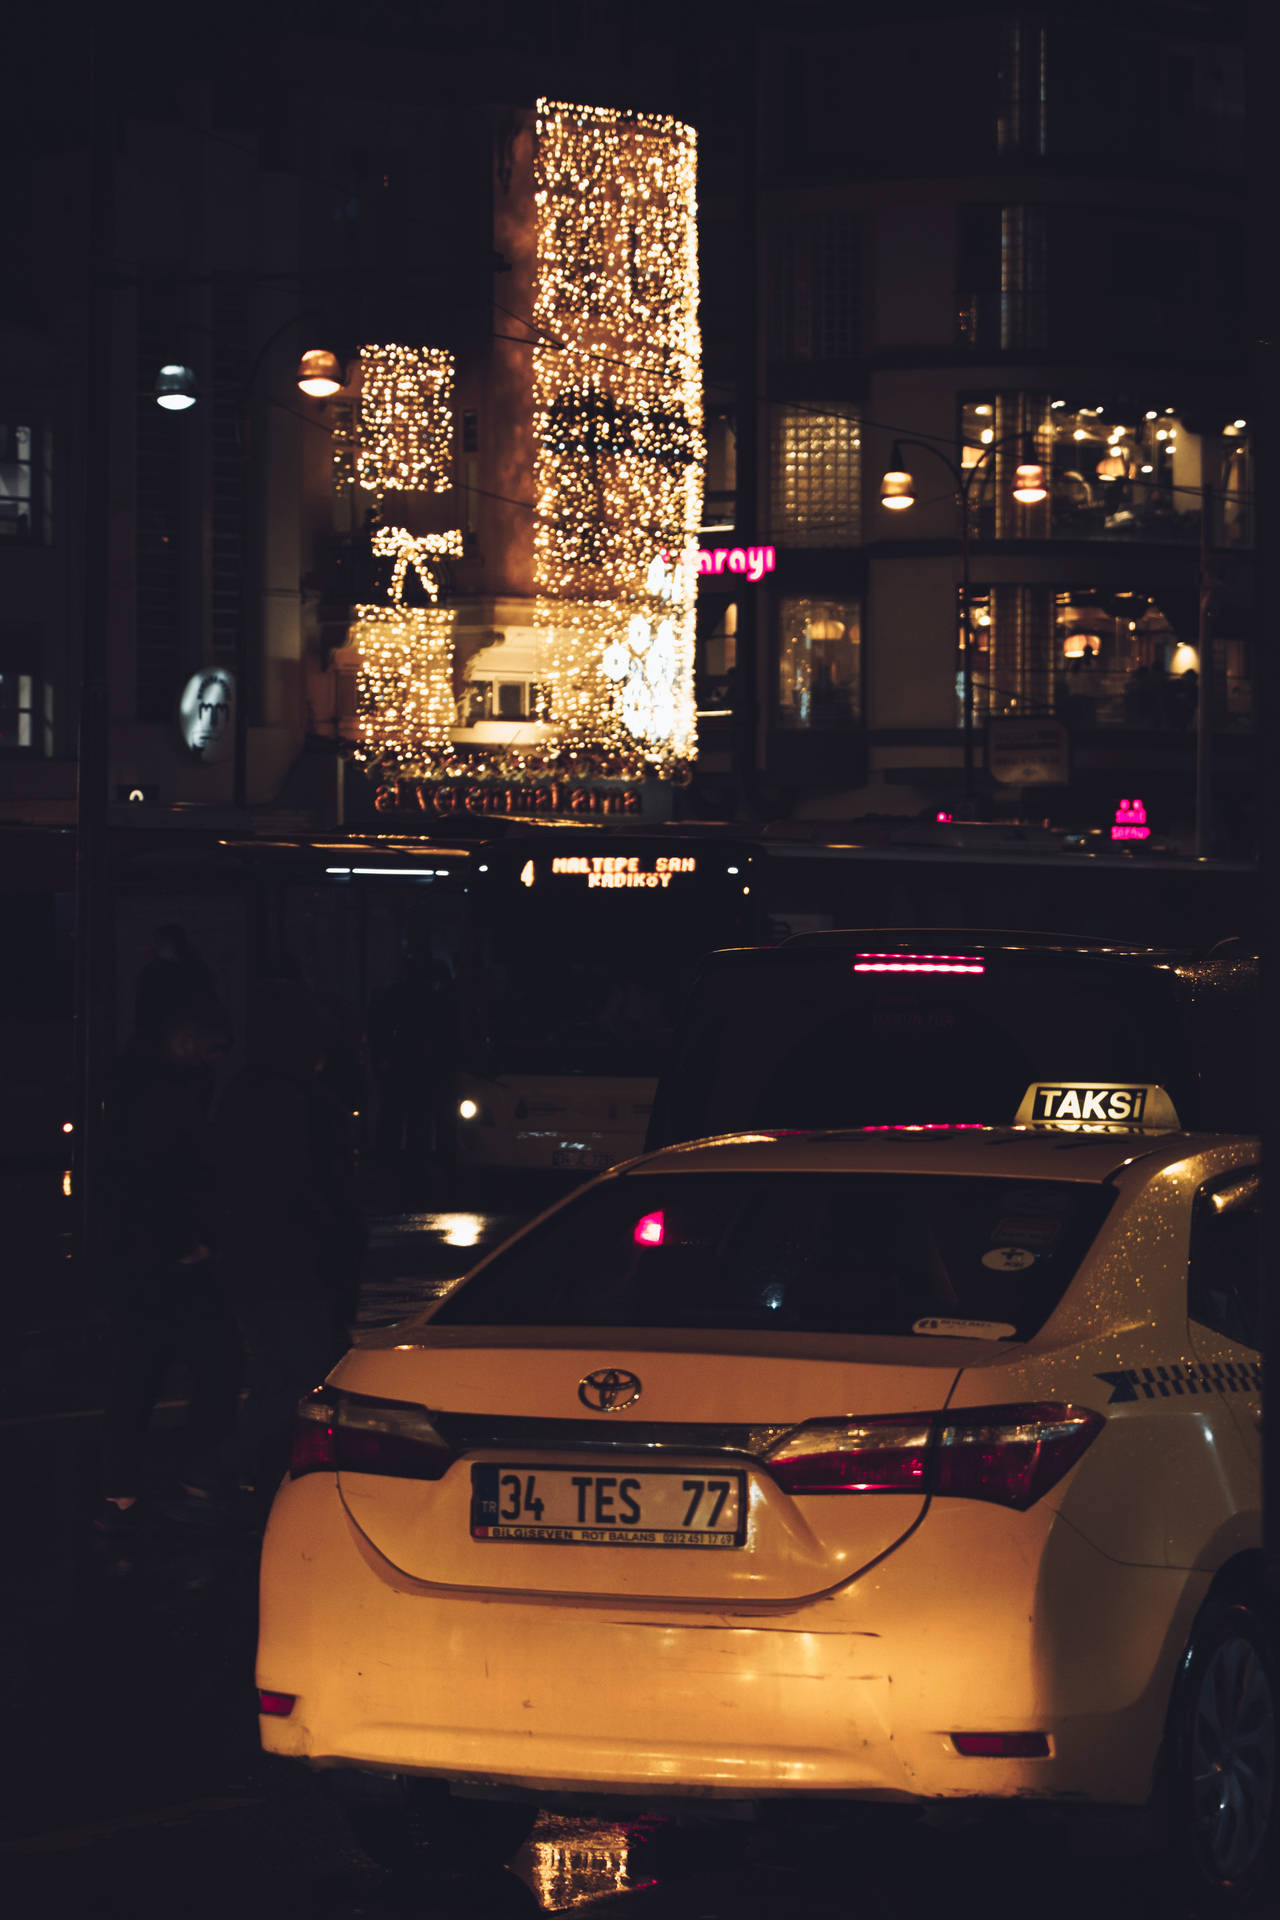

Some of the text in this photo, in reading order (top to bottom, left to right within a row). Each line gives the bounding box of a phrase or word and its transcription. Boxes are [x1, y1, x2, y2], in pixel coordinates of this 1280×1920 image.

[520, 859, 535, 888] 4
[551, 856, 640, 874] MALTEPE
[501, 1474, 730, 1527] 34 TES 77
[582, 1530, 606, 1542] ROT
[608, 1531, 656, 1543] BALANS
